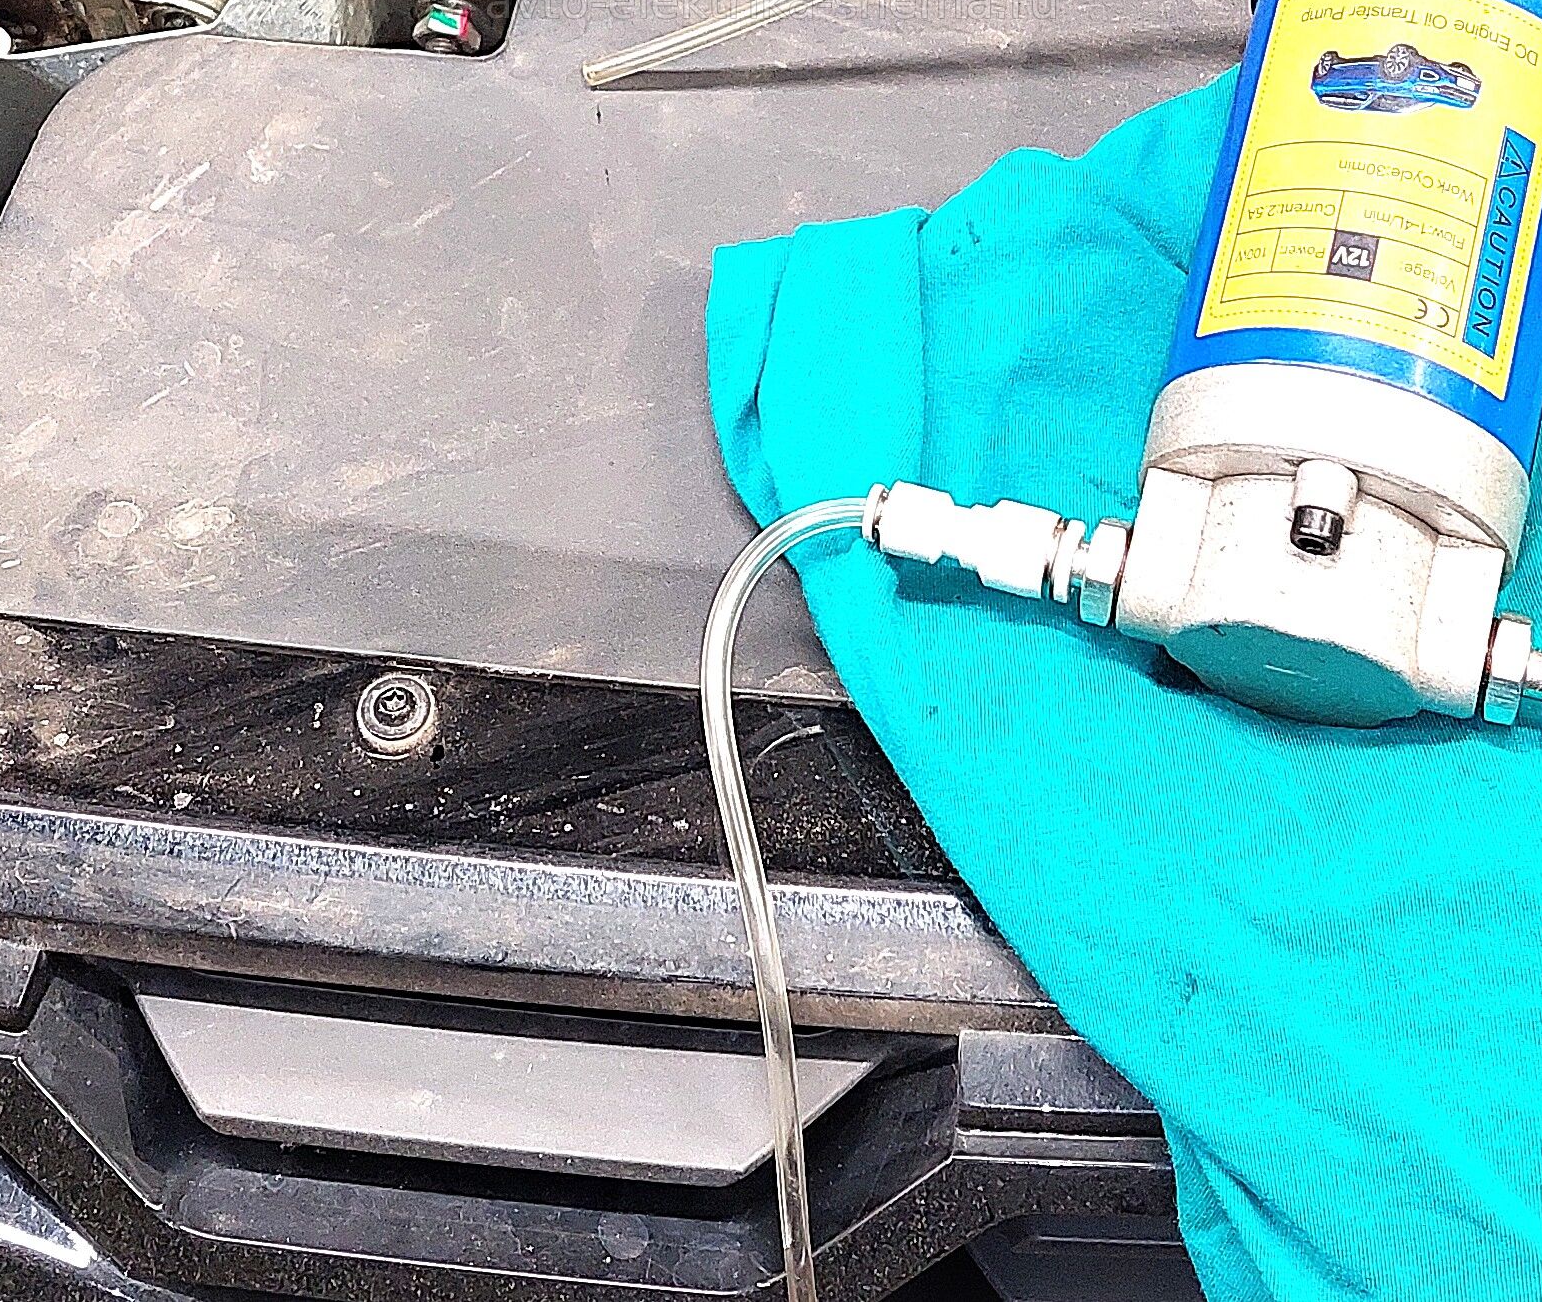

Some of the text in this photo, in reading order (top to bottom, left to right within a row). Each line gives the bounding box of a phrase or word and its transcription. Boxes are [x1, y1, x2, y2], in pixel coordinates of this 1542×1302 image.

[1301, 3, 1539, 67] DC Engine Oil Transfer Pump
[1338, 158, 1475, 205] Work Cycle:30min
[1246, 203, 1336, 222] Current:2.5A
[1235, 246, 1267, 263] 100W
[1331, 245, 1372, 268] 12V
[1471, 186, 1517, 338] CAUTION
